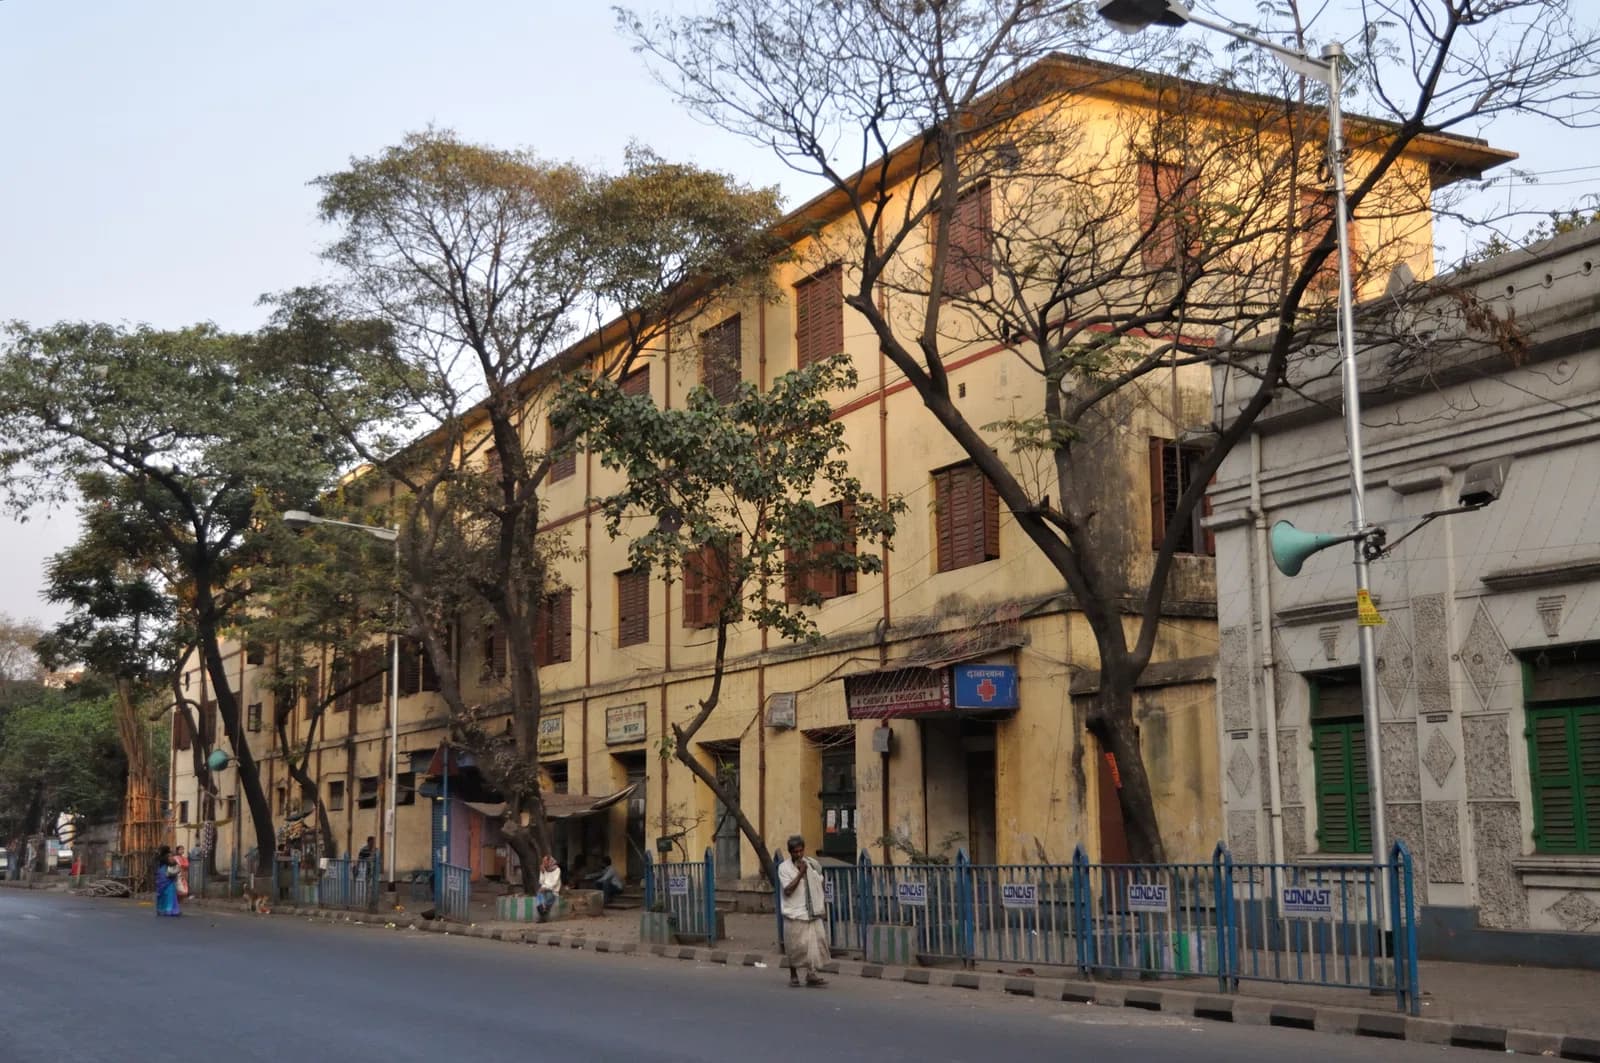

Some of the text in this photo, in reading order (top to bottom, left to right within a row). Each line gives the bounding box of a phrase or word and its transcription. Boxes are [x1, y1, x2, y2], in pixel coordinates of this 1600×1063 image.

[899, 884, 925, 896] CONCAST
[1004, 886, 1035, 898] CONCAST
[1130, 886, 1167, 900] CONCAST
[1284, 889, 1331, 904] CONCAST
